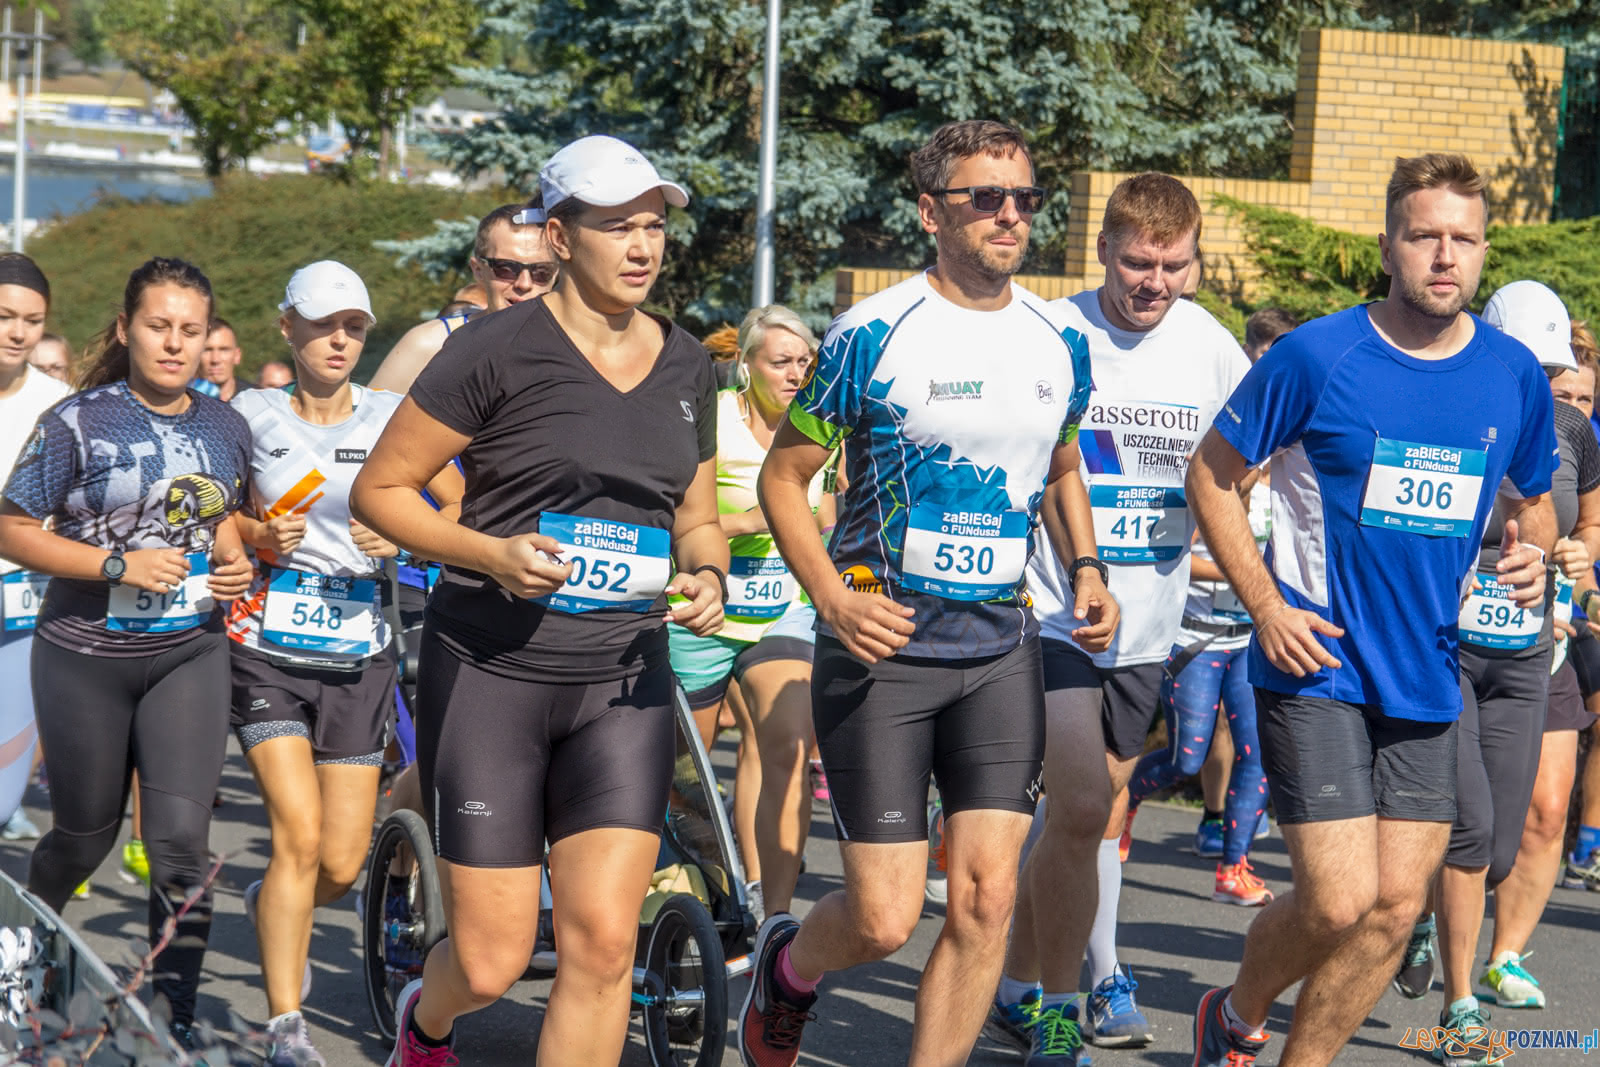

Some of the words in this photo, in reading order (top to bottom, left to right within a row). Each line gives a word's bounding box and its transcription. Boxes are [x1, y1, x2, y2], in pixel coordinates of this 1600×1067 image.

[935, 381, 984, 395] MUAY
[269, 448, 290, 458] 4F
[1405, 446, 1462, 465] zaBIEGaj
[1404, 459, 1411, 468] o
[1413, 459, 1460, 473] FUNdusze
[1117, 488, 1166, 501] zaBIEGaj
[1395, 477, 1453, 510] 306
[1116, 500, 1123, 508] o
[1124, 499, 1164, 508] FUNdusze
[942, 511, 1003, 529] zaBIEGaj
[1110, 515, 1160, 540] 417
[574, 521, 639, 545] zaBIEGaj
[941, 525, 949, 533] o
[951, 525, 1001, 537] FUNdusze
[574, 536, 582, 545] o
[584, 537, 637, 553] FUNdusze
[934, 542, 994, 576] 530
[566, 556, 631, 593] 052
[136, 585, 188, 612] 514
[744, 581, 782, 600] 540
[291, 601, 343, 630] 548
[1477, 603, 1525, 629] 594
